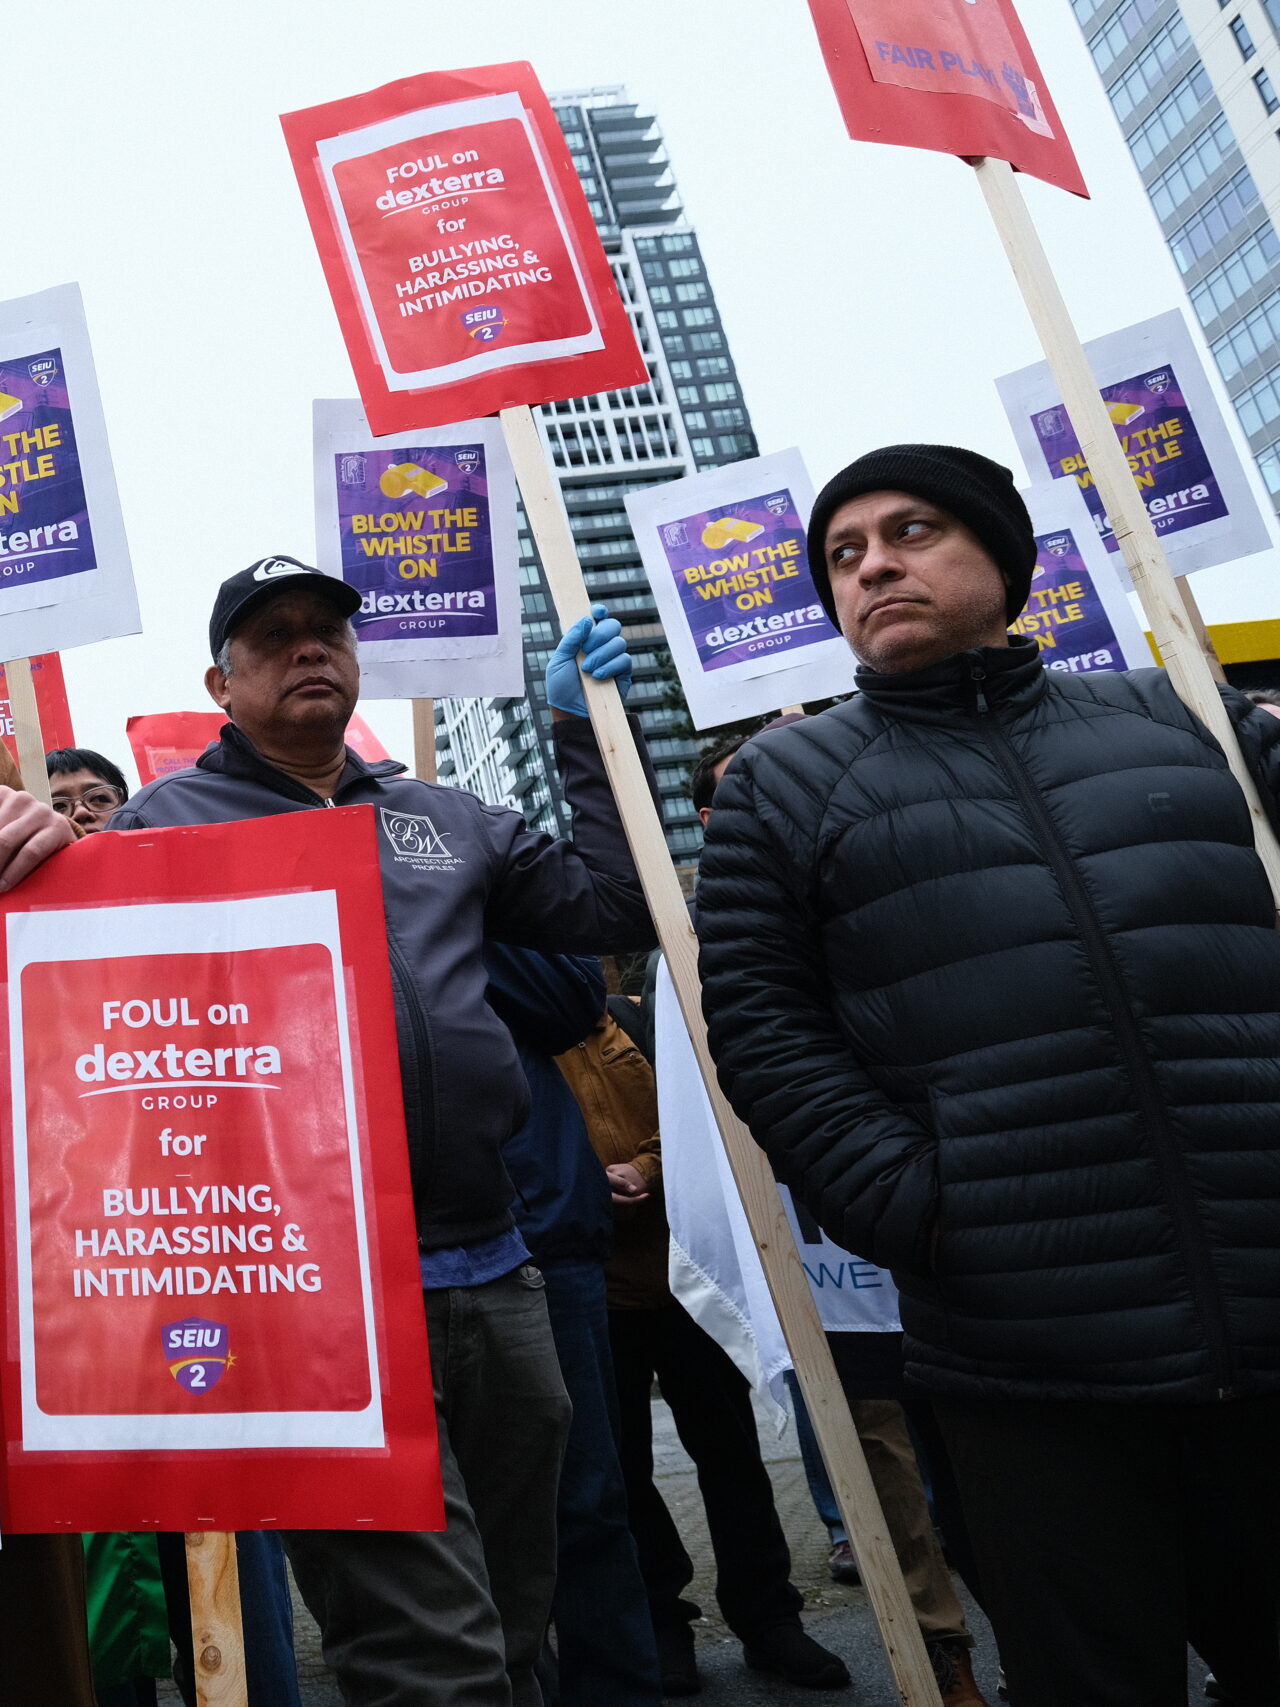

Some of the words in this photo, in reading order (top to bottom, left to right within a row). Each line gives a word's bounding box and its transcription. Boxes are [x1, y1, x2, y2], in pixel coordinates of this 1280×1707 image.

[875, 40, 937, 71] FAIR
[386, 155, 448, 183] FOUL
[451, 149, 479, 165] on
[375, 167, 505, 211] dexterra
[422, 197, 470, 215] GROUP
[436, 217, 467, 235] for
[408, 234, 520, 274] BULLYING,
[395, 253, 519, 298] HARASSING
[523, 249, 540, 265] &
[399, 266, 553, 317] INTIMIDATING
[465, 308, 497, 325] SEIU
[482, 327, 494, 340] 2
[31, 361, 52, 373] SEIU
[40, 375, 49, 385] 2
[1156, 384, 1164, 393] 2
[2, 423, 61, 457] THE
[1060, 435, 1128, 475] BL
[1131, 417, 1184, 447] THE
[457, 453, 476, 462] SEIU
[464, 464, 471, 472] 2
[1075, 439, 1182, 489] WSTLE
[1134, 470, 1155, 491] N
[351, 511, 425, 534] BLOW
[428, 507, 478, 528] THE
[361, 532, 471, 557] WHISTLE
[1056, 547, 1064, 555] 2
[398, 559, 438, 579] ON
[684, 552, 751, 584] BLOW
[753, 538, 801, 565] THE
[695, 560, 800, 601] WHISTLE
[360, 590, 485, 614] dexterra
[735, 588, 774, 611] ON
[1031, 581, 1085, 608] THE
[399, 619, 446, 630] GROUP
[705, 604, 825, 648] dexterra
[1006, 603, 1085, 635] ISTLE
[748, 635, 792, 652] GROUP
[1033, 631, 1057, 651] N
[1042, 648, 1114, 673] erra
[394, 856, 466, 865] ARCHITECTURAL
[103, 997, 199, 1030] FOUL
[207, 1002, 249, 1026] on
[75, 1042, 282, 1083] dexterra
[141, 1095, 218, 1111] GROUP
[158, 1127, 207, 1157] for
[103, 1184, 282, 1218] BULLYING,
[75, 1223, 273, 1258] HARASSING
[282, 1223, 308, 1252] &
[73, 1264, 322, 1298] INTIMIDATING
[802, 1261, 882, 1289] WE
[168, 1328, 221, 1349] SEIU
[189, 1364, 207, 1388] 2
